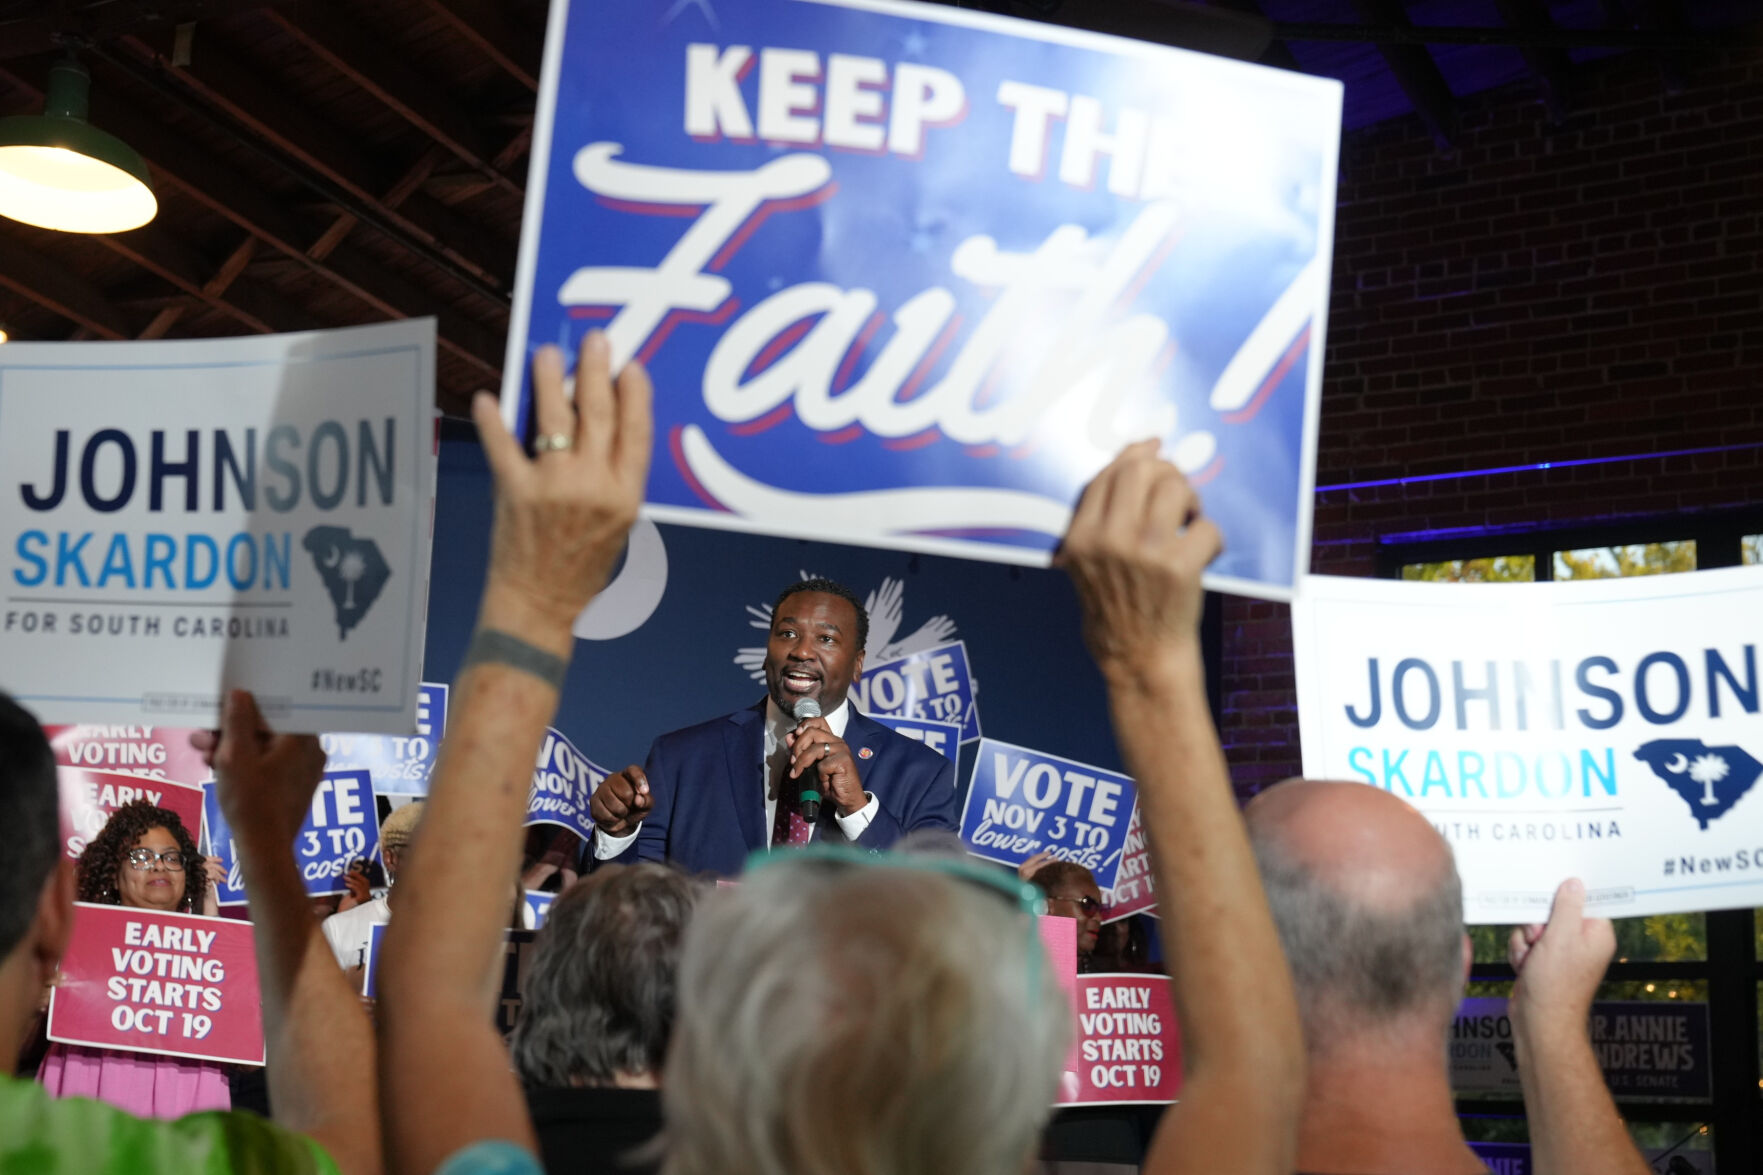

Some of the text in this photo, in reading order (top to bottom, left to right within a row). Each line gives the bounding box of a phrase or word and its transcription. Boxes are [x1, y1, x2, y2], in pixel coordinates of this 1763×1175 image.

[684, 43, 1165, 199] KEEP TH
[20, 417, 396, 514] JOHNSON
[13, 530, 291, 591] SKARDON
[4, 611, 290, 638] FOR SOUTH CAROLINA
[311, 669, 382, 692] #NewSC
[846, 653, 960, 715] VOTE
[1344, 644, 1762, 731] JOHNSON
[66, 742, 167, 765] VOTING
[392, 737, 429, 760] TO
[994, 752, 1122, 827] VOTE
[1347, 746, 1619, 799] SKARDON
[312, 778, 364, 827] TE
[302, 827, 366, 857] 3 TO
[982, 798, 1046, 834] NOV
[1048, 816, 1068, 840] 3
[1074, 822, 1110, 852] TO
[1492, 820, 1623, 840] CAROLINA
[971, 818, 1122, 874] lower costs!
[124, 921, 217, 954] EARLY
[111, 947, 225, 983] VOTING
[107, 975, 223, 1012] STARTS
[1086, 987, 1151, 1010] EARLY
[111, 1004, 213, 1040] OCT 19
[1080, 1012, 1162, 1036] VOTING
[1082, 1038, 1164, 1062] STARTS
[1597, 1043, 1695, 1071] NDREWS
[1091, 1065, 1162, 1088] OCT 19
